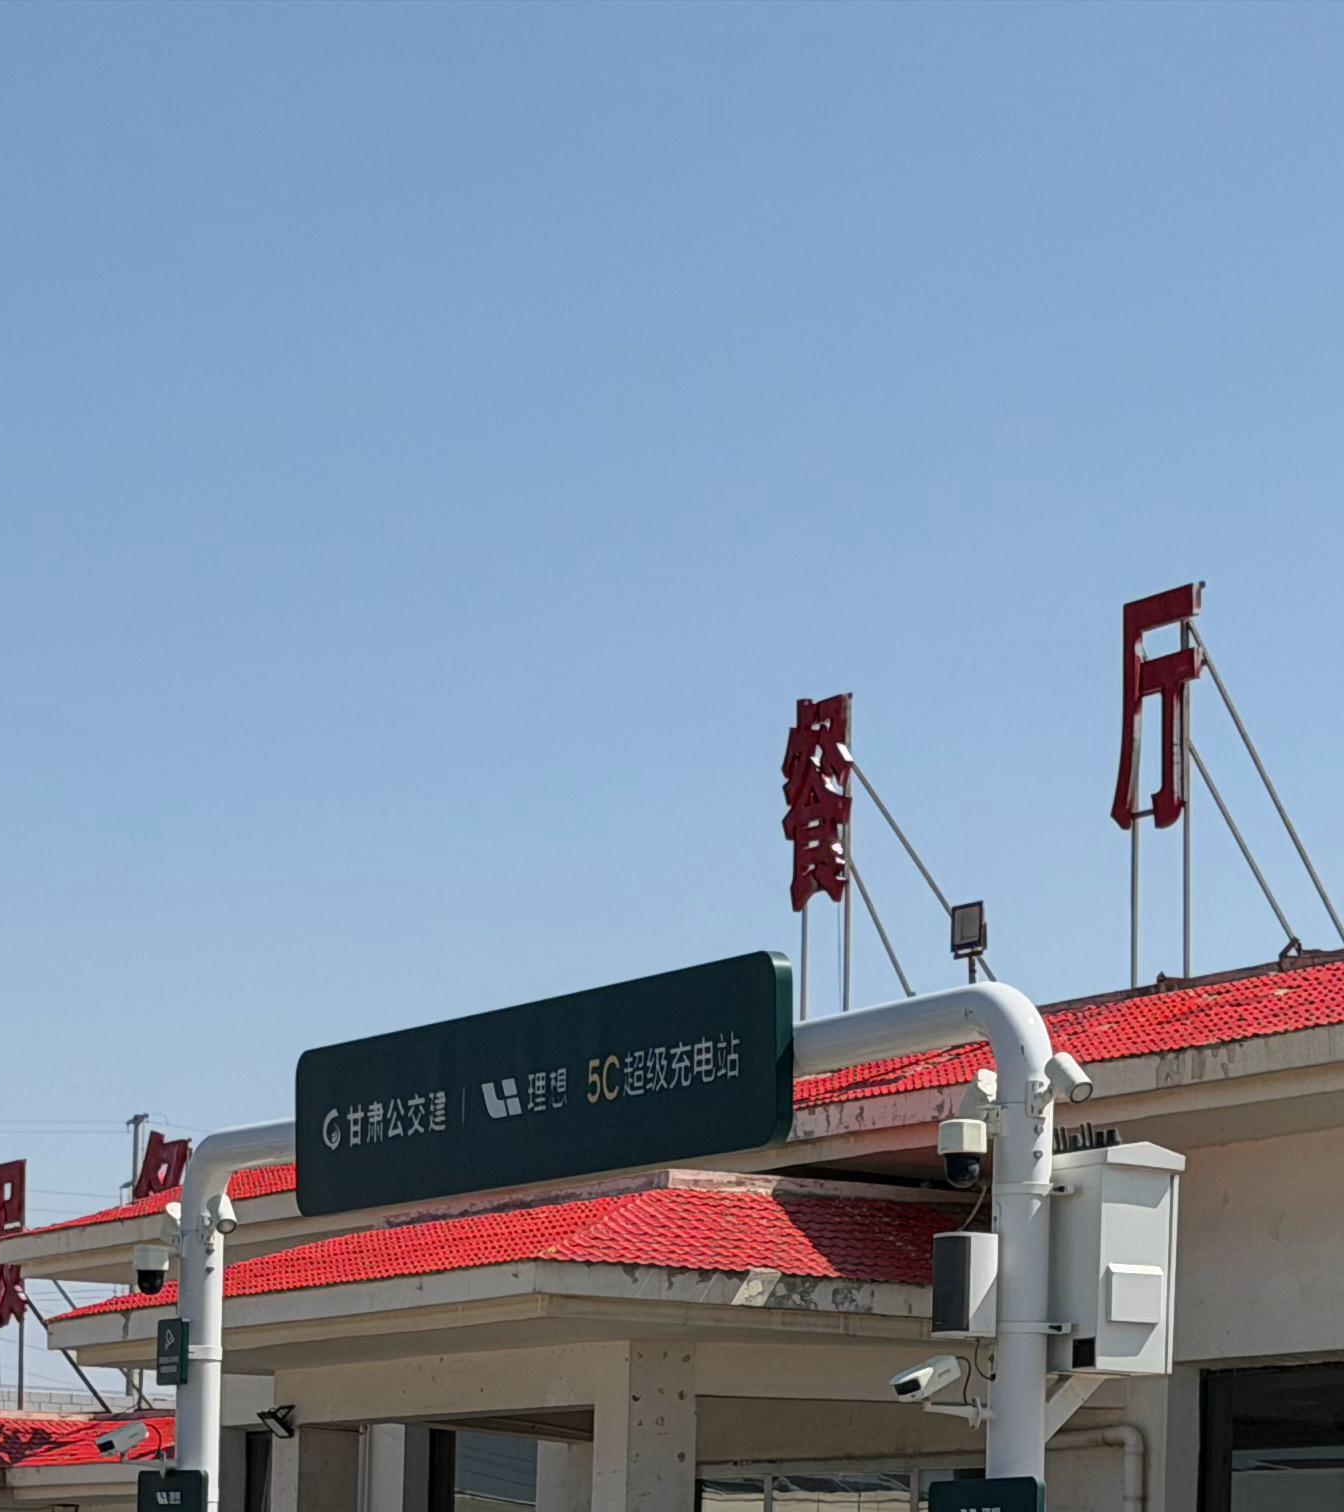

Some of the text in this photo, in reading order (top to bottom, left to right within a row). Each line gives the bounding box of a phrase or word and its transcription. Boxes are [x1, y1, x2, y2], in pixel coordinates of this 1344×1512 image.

[346, 1030, 741, 1148] 甘肃公交建 理想 5C超级充电站
